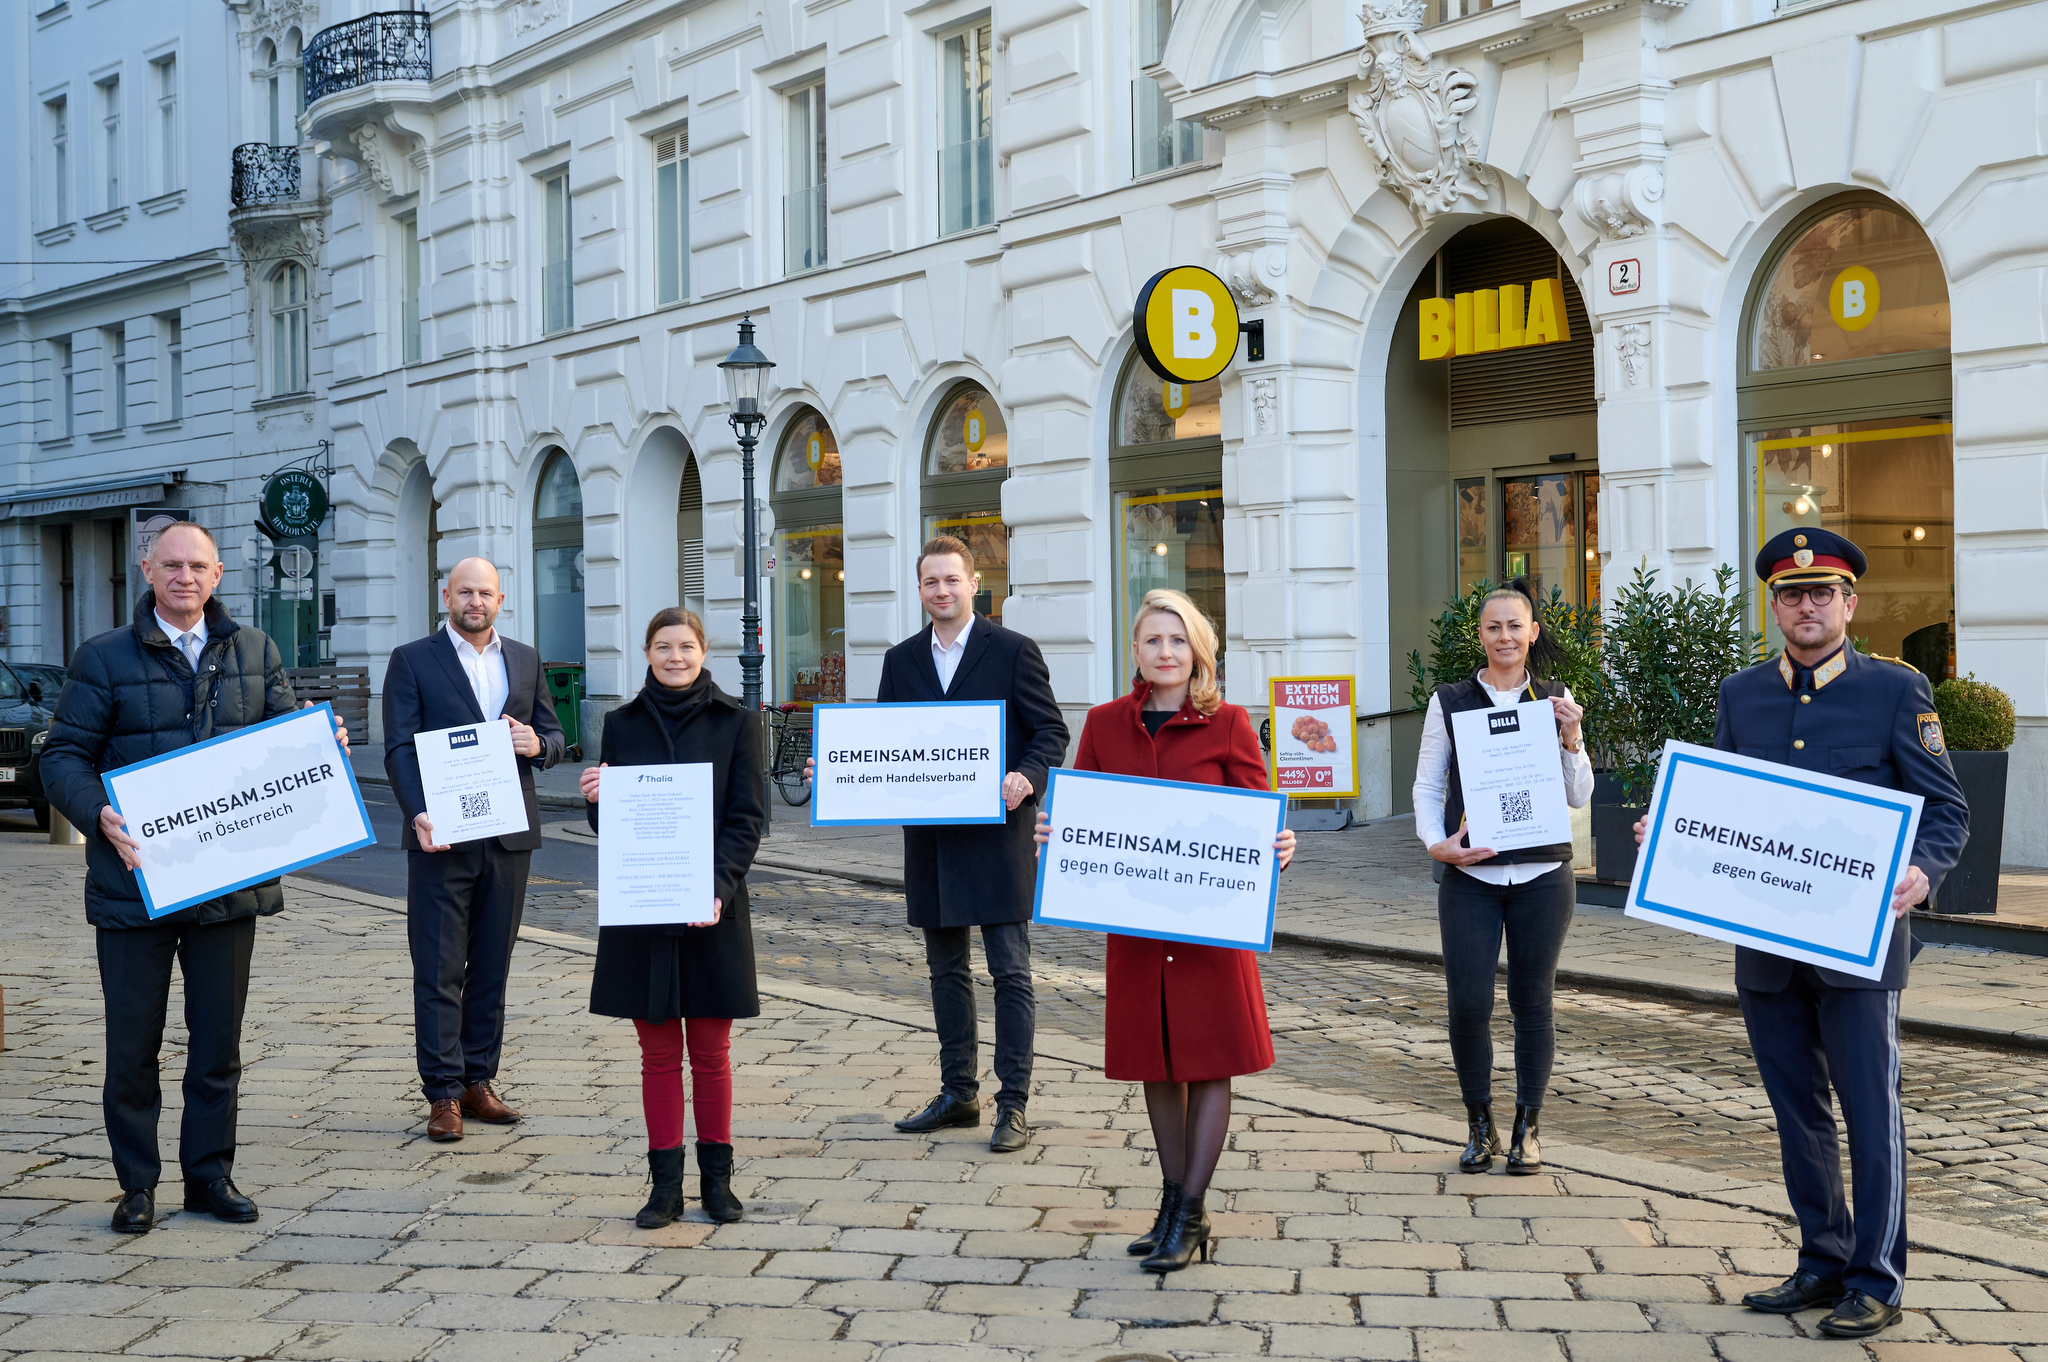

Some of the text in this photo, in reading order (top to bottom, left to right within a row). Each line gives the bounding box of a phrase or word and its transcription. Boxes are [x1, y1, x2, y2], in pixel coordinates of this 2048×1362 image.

[1620, 264, 1629, 284] 2
[1843, 280, 1866, 318] B
[1172, 288, 1217, 360] B
[1419, 278, 1571, 361] BILLA
[969, 418, 980, 443] B
[810, 443, 820, 463] B
[280, 474, 313, 488] OSTERIA
[272, 516, 320, 536] RISTORANTE
[1285, 683, 1339, 695] EXTREM
[1286, 694, 1340, 705] AKTION
[1490, 716, 1517, 728] BILLA
[451, 733, 476, 744] BILLA
[828, 748, 990, 763] GEMEINSAM.SICHER
[645, 774, 673, 783] Thalia
[836, 772, 976, 784] mit dem Handelsverband
[142, 763, 335, 838] GEMEINSAM.SICHER
[198, 802, 294, 843] in Österreich
[1062, 827, 1261, 865] GEMEINSAM.SICHER
[1674, 817, 1876, 881] GEMEINSAM.SICHER
[1060, 858, 1256, 892] gegen Gewalt an Frauen
[1712, 861, 1813, 895] gegen Gewalt
